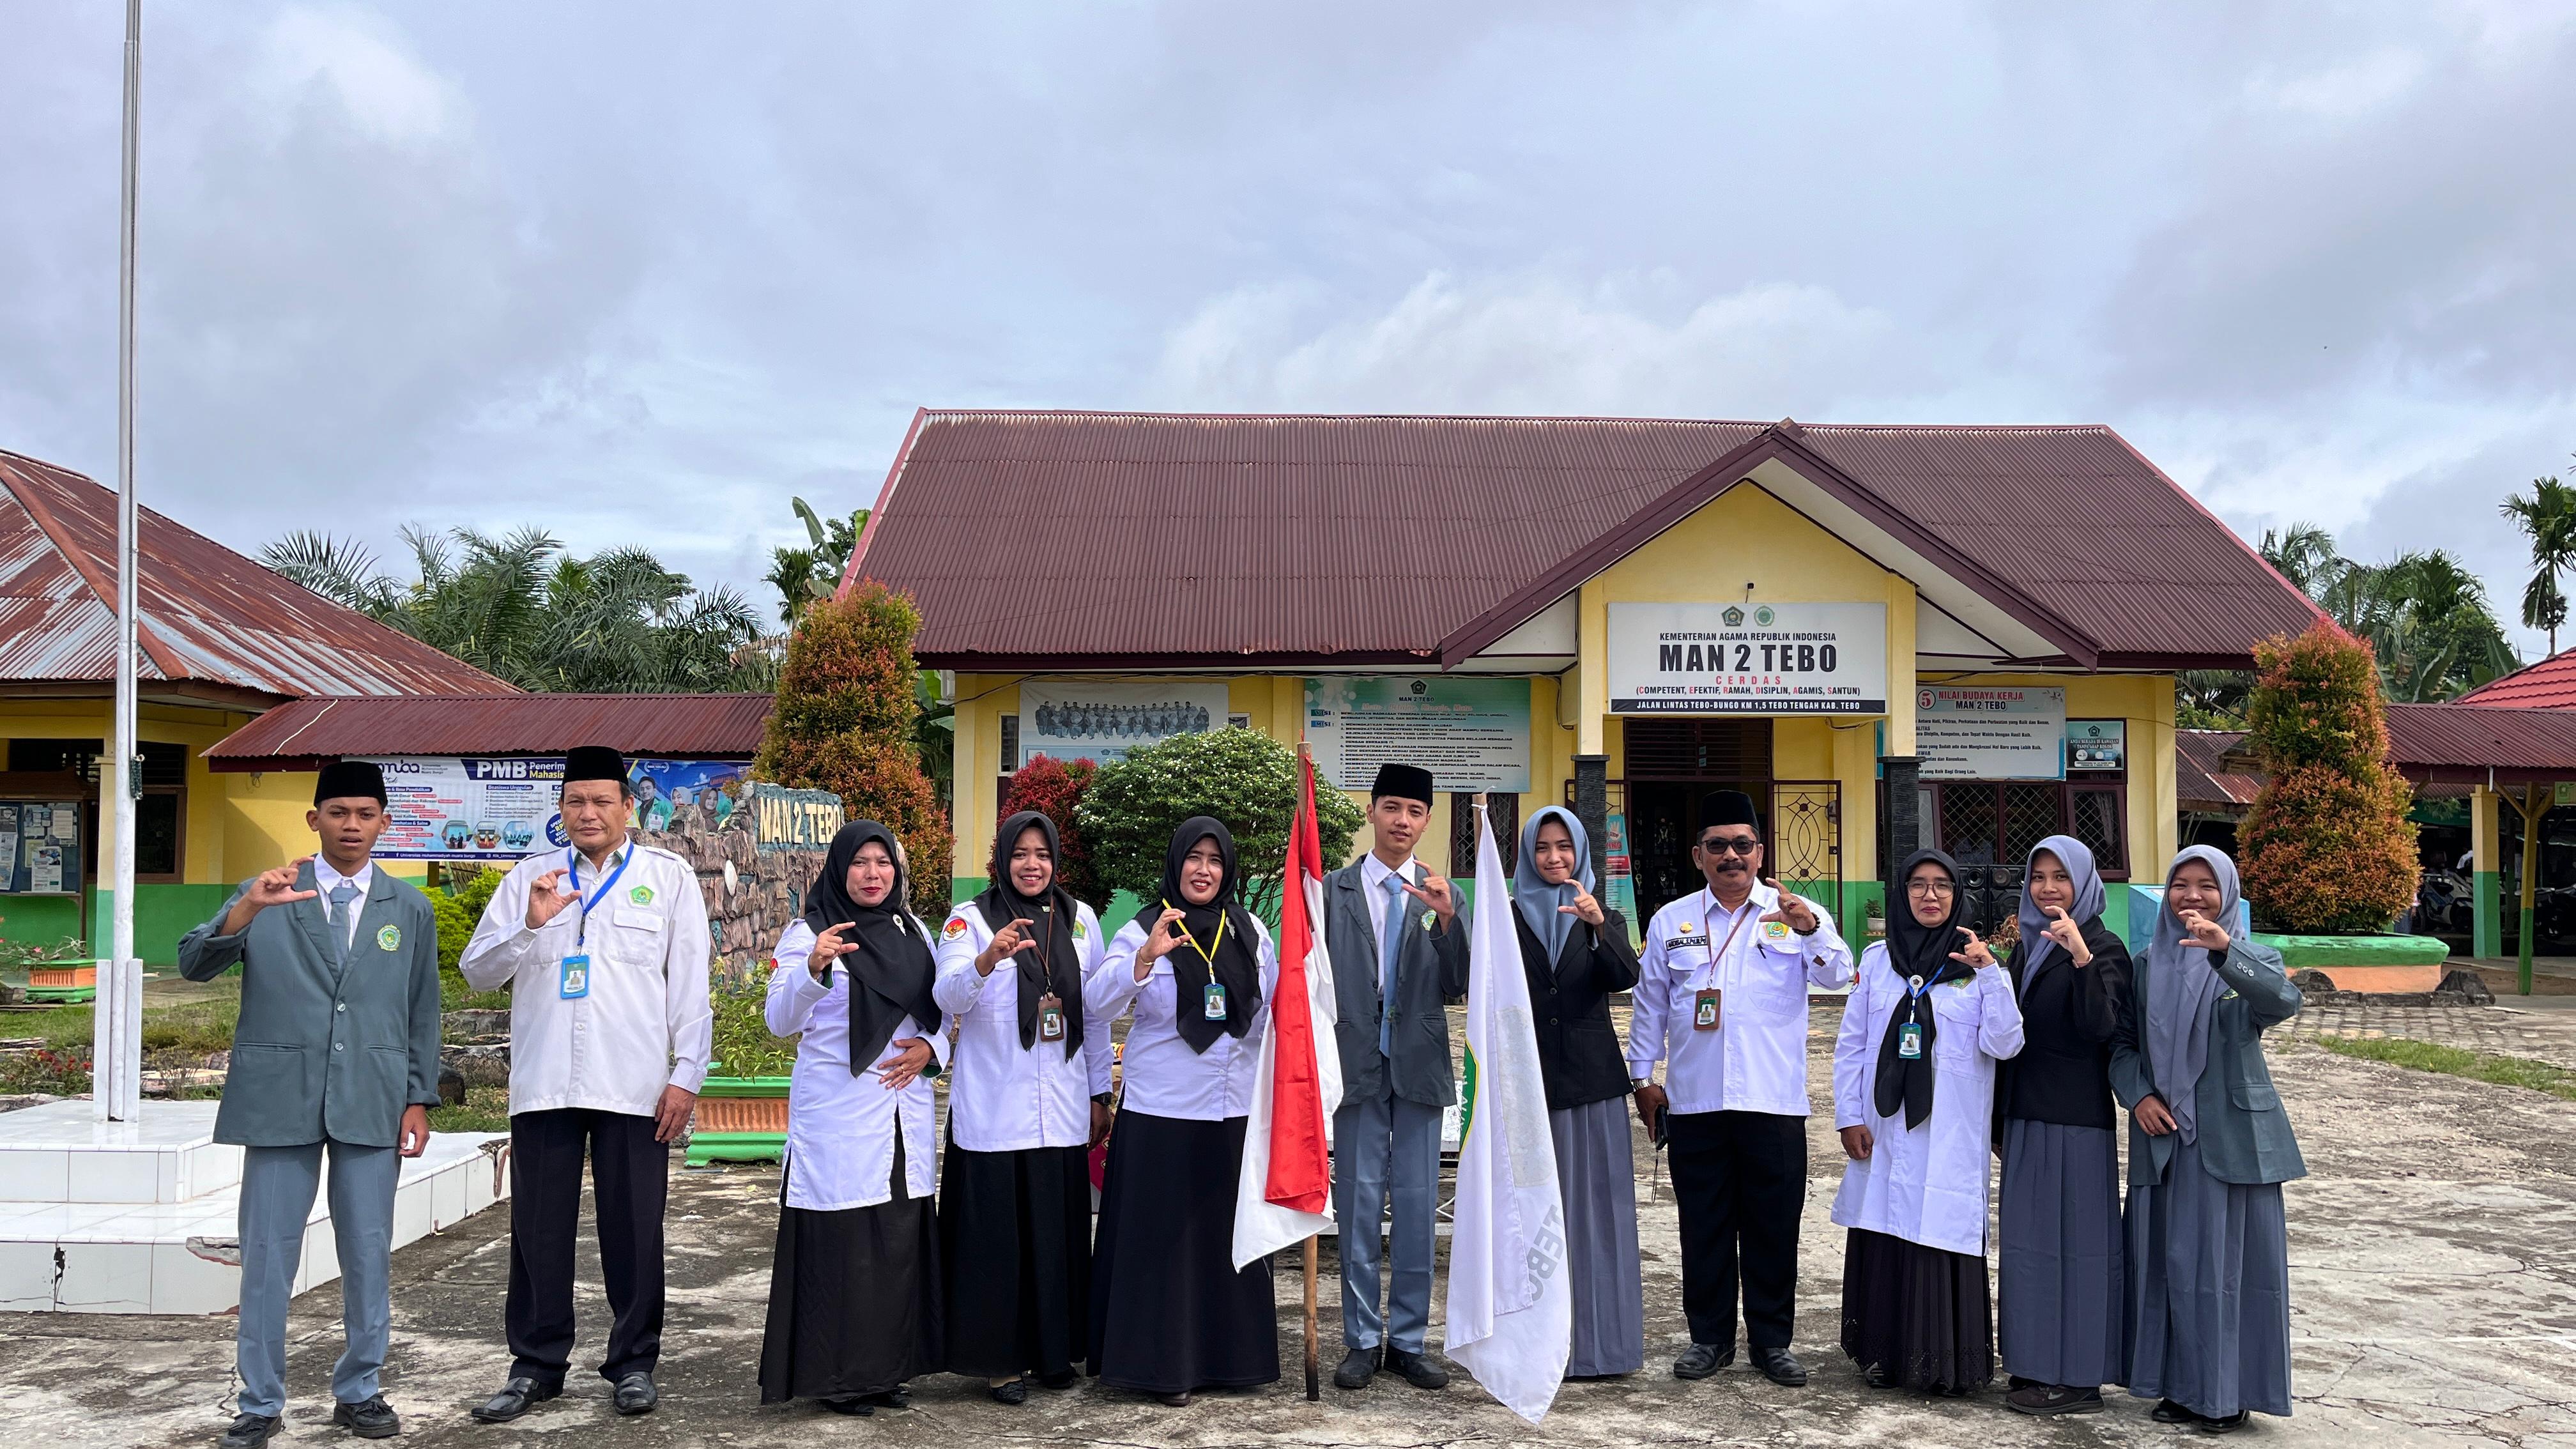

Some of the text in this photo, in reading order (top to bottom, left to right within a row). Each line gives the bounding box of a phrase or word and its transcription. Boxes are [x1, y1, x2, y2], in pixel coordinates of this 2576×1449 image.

[1660, 632, 1836, 641] KEMENTERIAN AGAMA REPUBLIK INDONESIA
[1660, 644, 1836, 672] MAN 2 TEBO
[1636, 686, 1860, 696] (COMPETENT, EFEKTIF, RAMAH, DISIPLIN, AGAMIS, SANTUN)
[1938, 691, 2023, 700] NILAI BUDAYA KERJA
[1921, 693, 1931, 707] 5
[1636, 701, 1660, 709] JALAN
[1662, 701, 1689, 709] LINTAS
[1754, 702, 1767, 710] 1,5
[1768, 702, 1788, 710] TEBO
[1790, 702, 1819, 710] TENGAH
[1821, 702, 1839, 710] KAB.
[1841, 702, 1860, 710] TEBO
[1956, 701, 2006, 710] MAN 2 TEBO
[477, 761, 527, 778] PMB
[760, 797, 841, 844] MAN 2 TEBO
